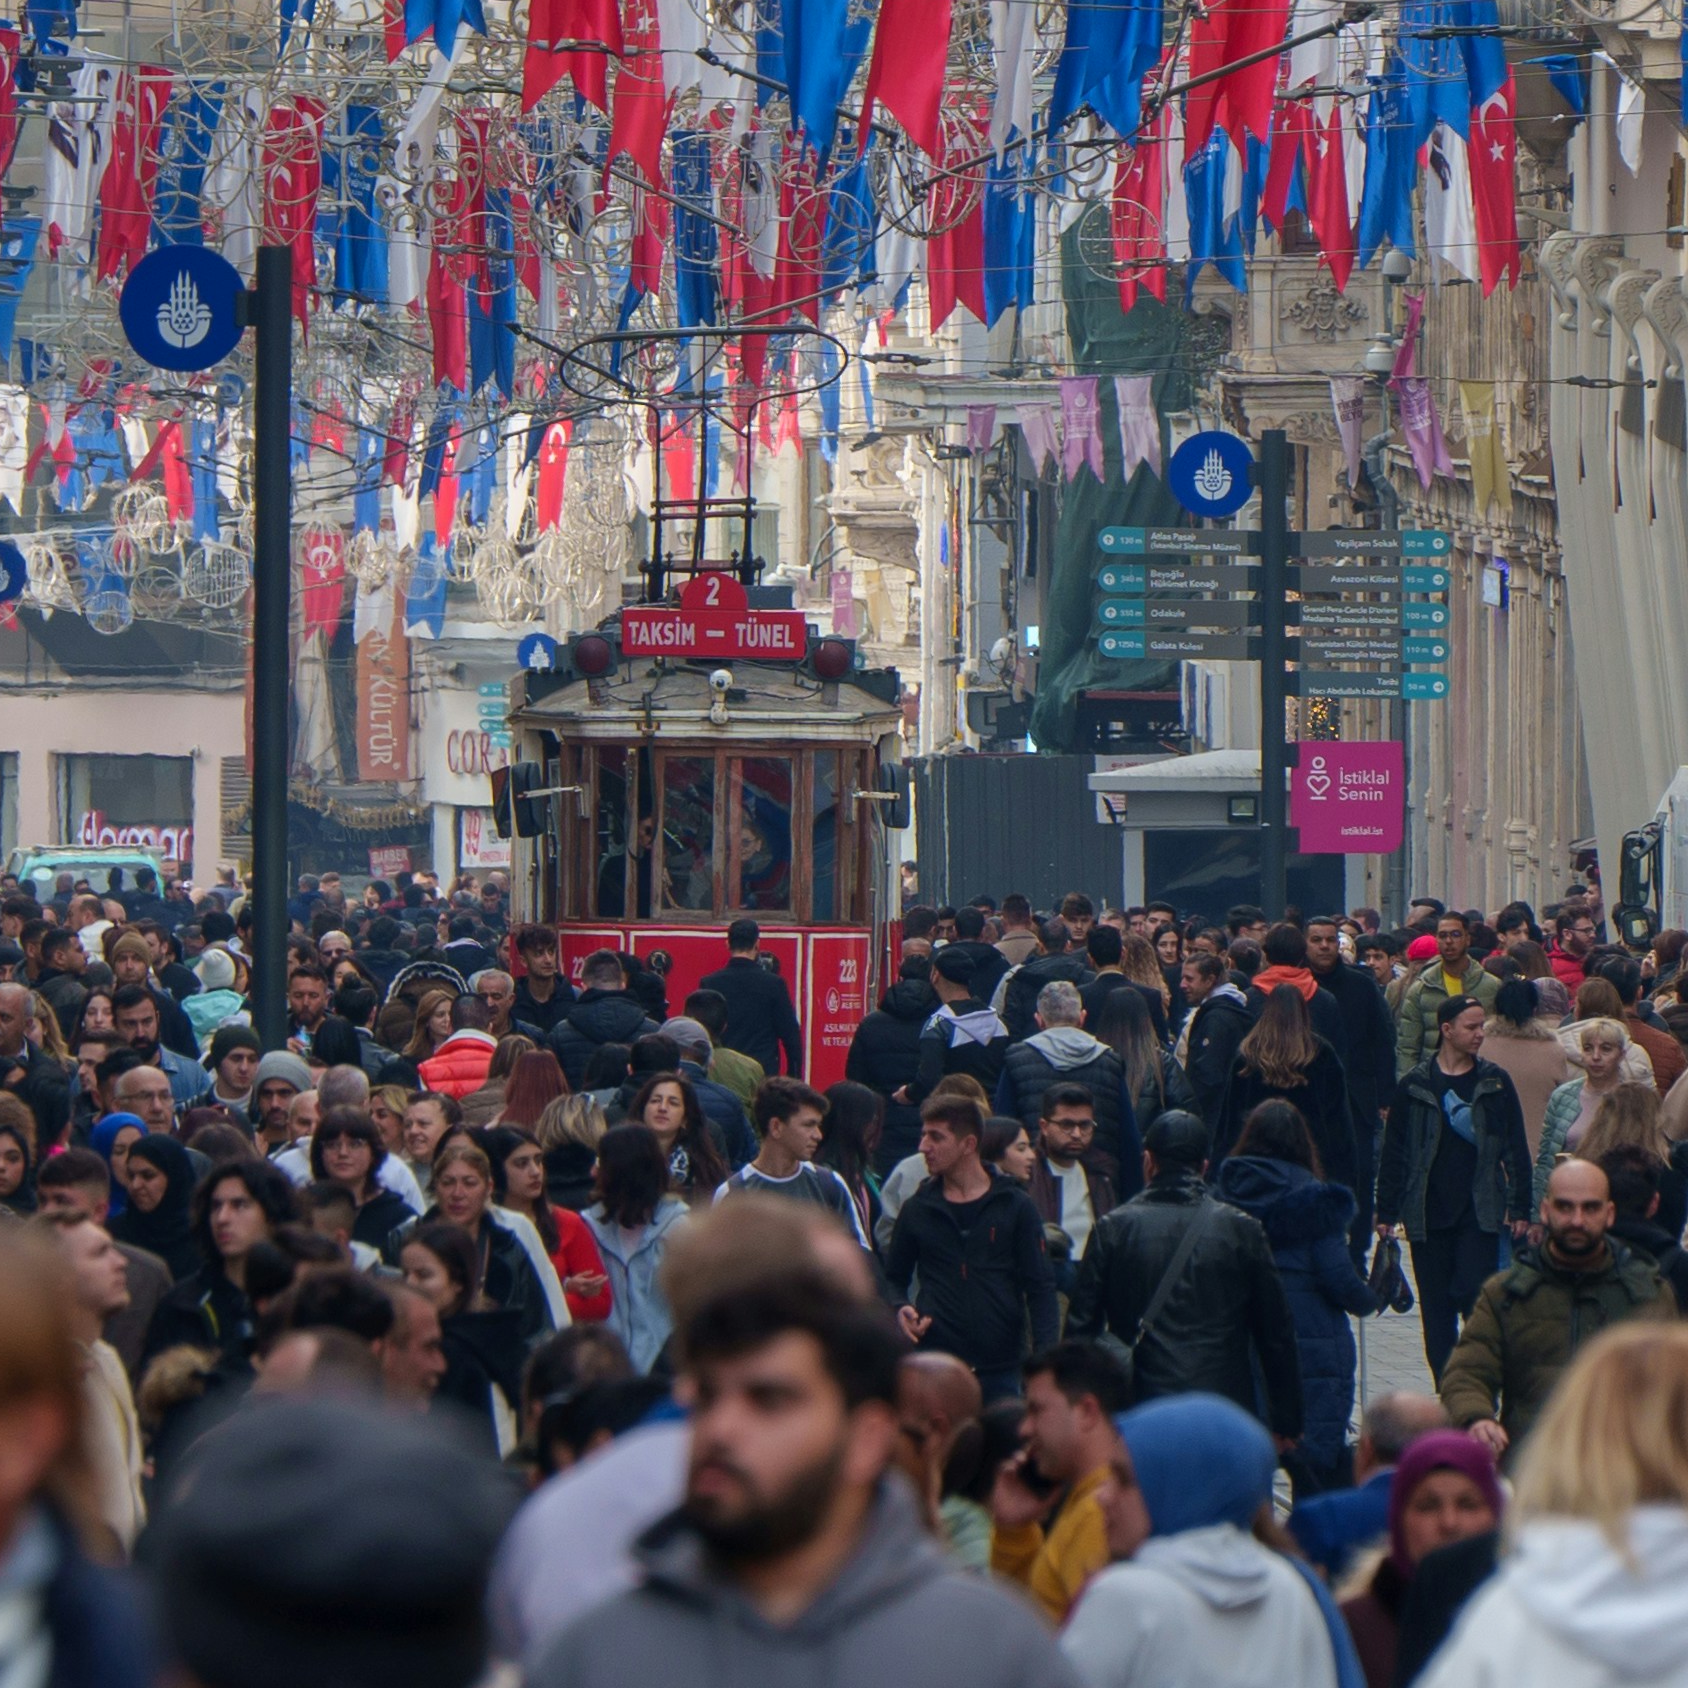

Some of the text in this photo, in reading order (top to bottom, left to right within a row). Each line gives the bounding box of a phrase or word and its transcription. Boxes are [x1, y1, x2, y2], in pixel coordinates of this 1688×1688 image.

[1335, 539, 1369, 550] Yeşilçam
[1371, 538, 1399, 549] Sokak
[705, 577, 720, 606] 2
[1150, 609, 1185, 618] Odakule
[628, 616, 696, 647] TAKSİM
[735, 617, 795, 648] TÜNEL
[1150, 642, 1176, 651] Galata
[1178, 642, 1203, 651] Kulesi
[370, 673, 397, 768] KÜLTÜR
[1339, 766, 1390, 785] İstiklal
[1338, 786, 1384, 801] Senin
[839, 959, 858, 983] 223
